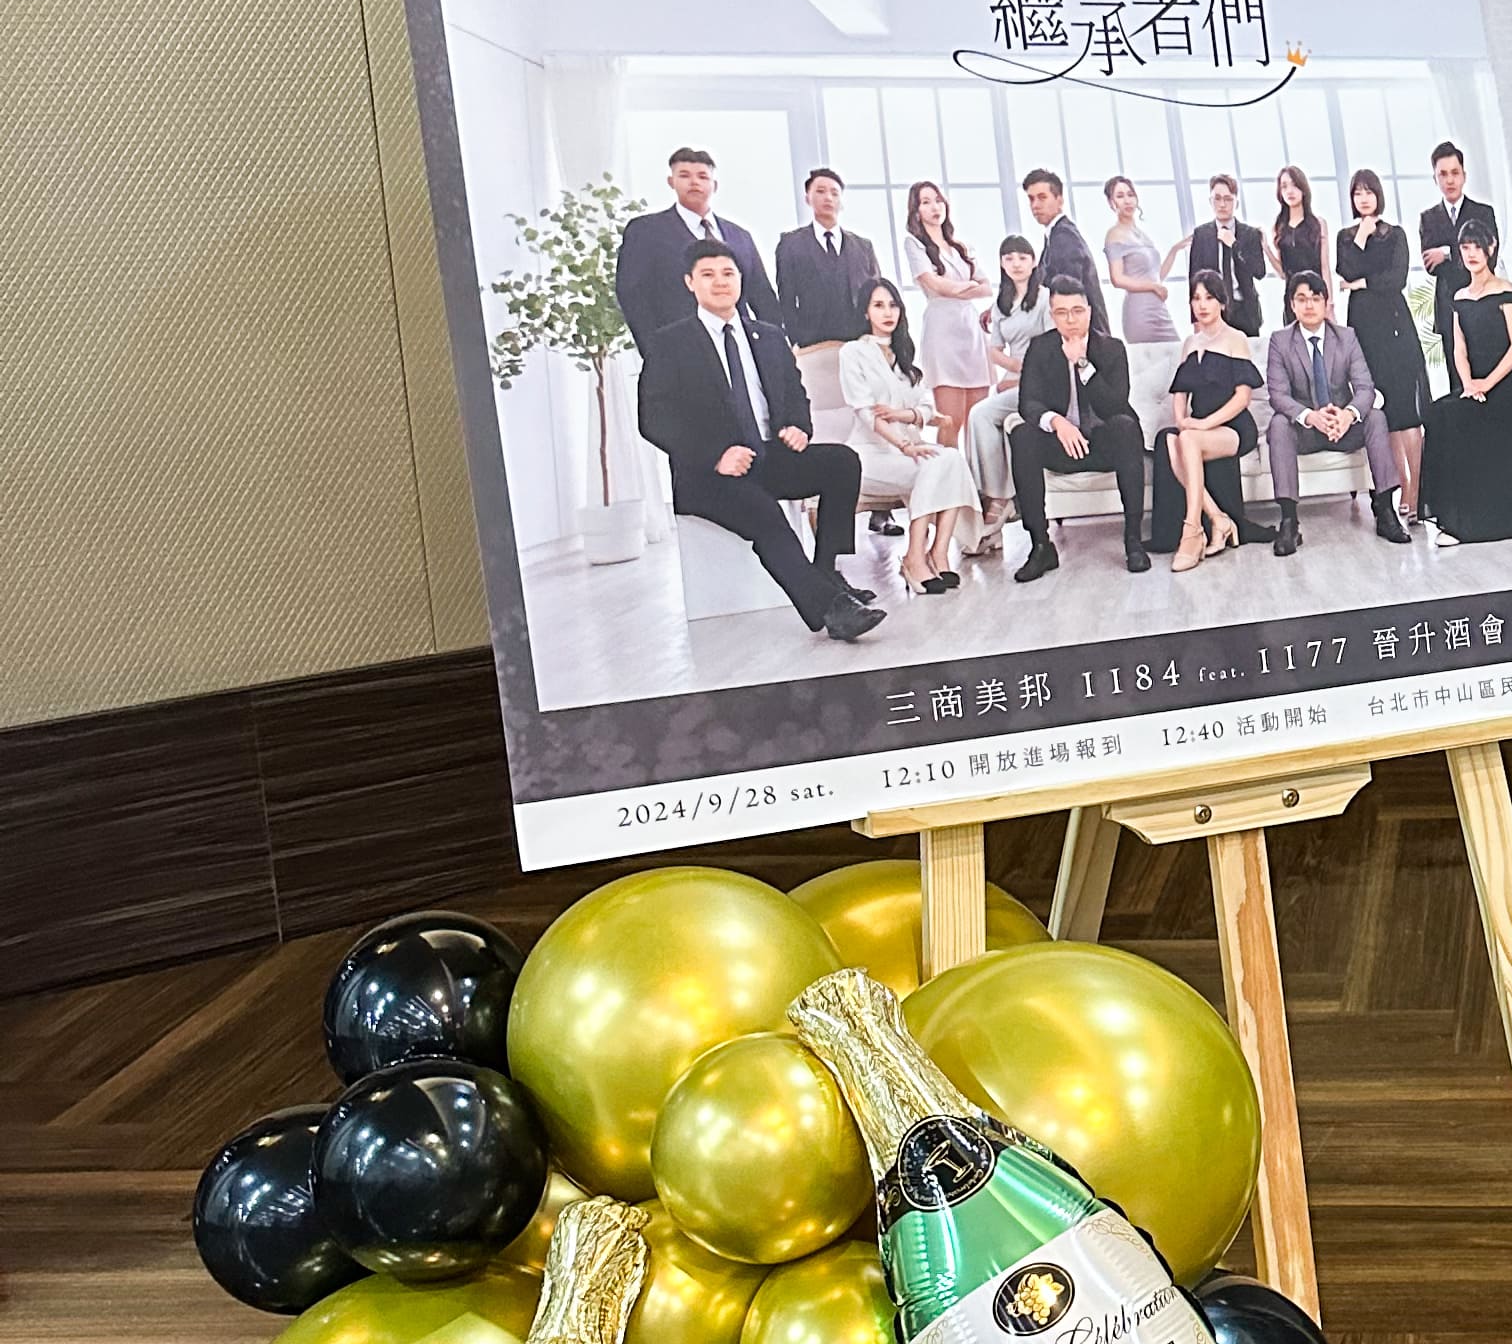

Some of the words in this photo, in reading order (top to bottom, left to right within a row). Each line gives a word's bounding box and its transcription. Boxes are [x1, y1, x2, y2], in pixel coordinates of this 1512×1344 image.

[885, 671, 1052, 727] 三商美邦
[1081, 658, 1182, 699] 1184
[1197, 665, 1247, 684] feat.
[1257, 636, 1349, 674] 1177
[1371, 612, 1507, 661] 晉升酒會
[1161, 720, 1225, 747] 12:40
[1236, 703, 1328, 737] 活動開始
[883, 759, 956, 789] 12:10
[967, 733, 1123, 778] 開放進場報到
[617, 784, 778, 828] 2024/9/28
[789, 782, 836, 802] sat.
